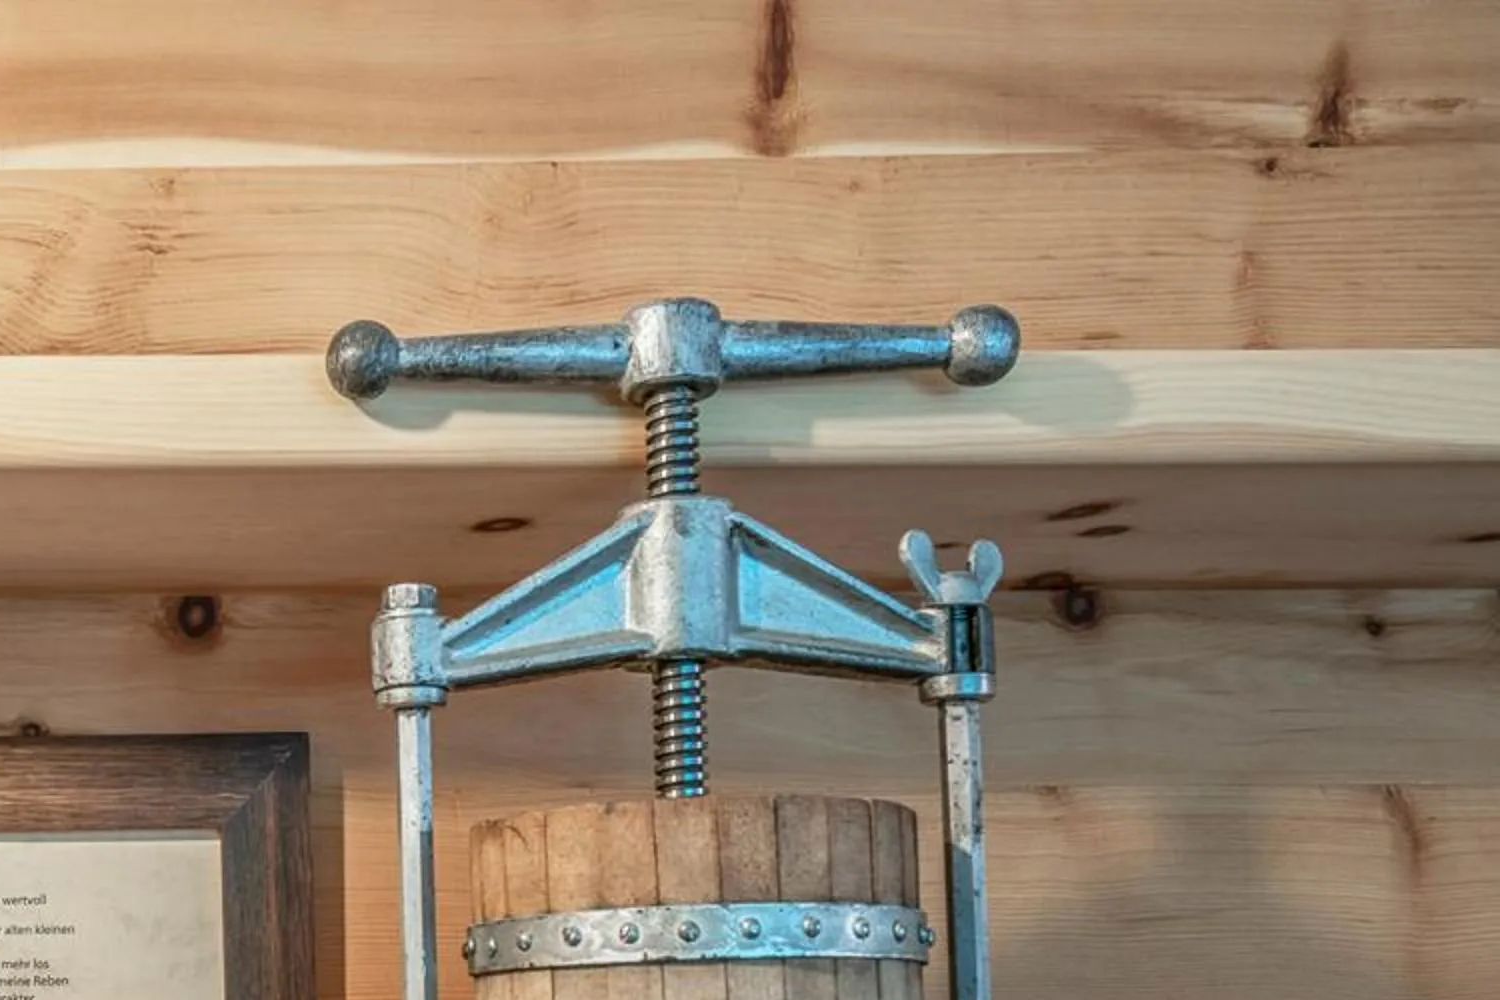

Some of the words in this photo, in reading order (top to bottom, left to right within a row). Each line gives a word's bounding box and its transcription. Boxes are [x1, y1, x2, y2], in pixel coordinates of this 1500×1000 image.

[2, 959, 30, 970] mehr
[34, 958, 49, 970] los
[34, 975, 69, 987] Reben
